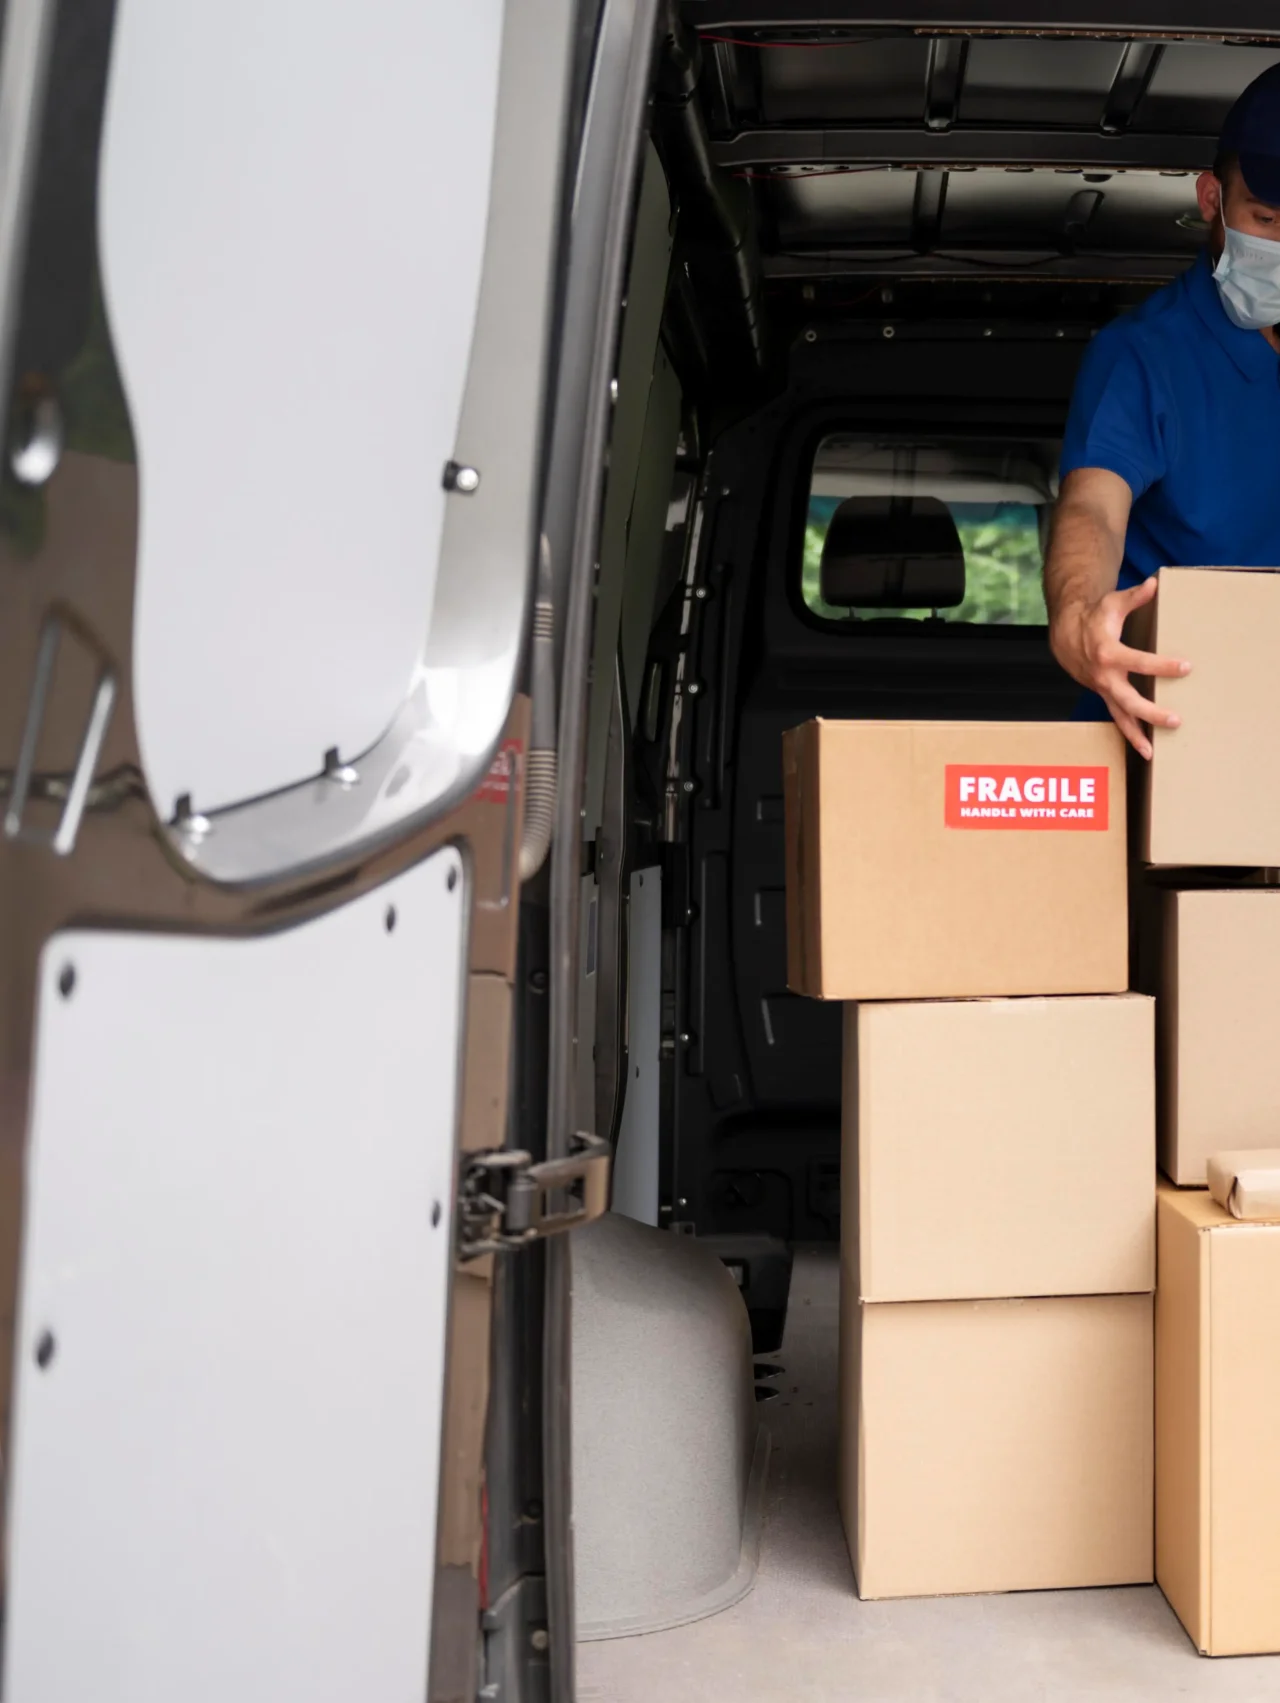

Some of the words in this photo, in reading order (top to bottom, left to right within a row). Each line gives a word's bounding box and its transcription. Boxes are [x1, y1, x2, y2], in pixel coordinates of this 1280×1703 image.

[959, 777, 1096, 803] FRAGILE
[960, 807, 1016, 818] HANDLE
[1020, 808, 1056, 818] WITH
[1059, 808, 1094, 818] CARE
